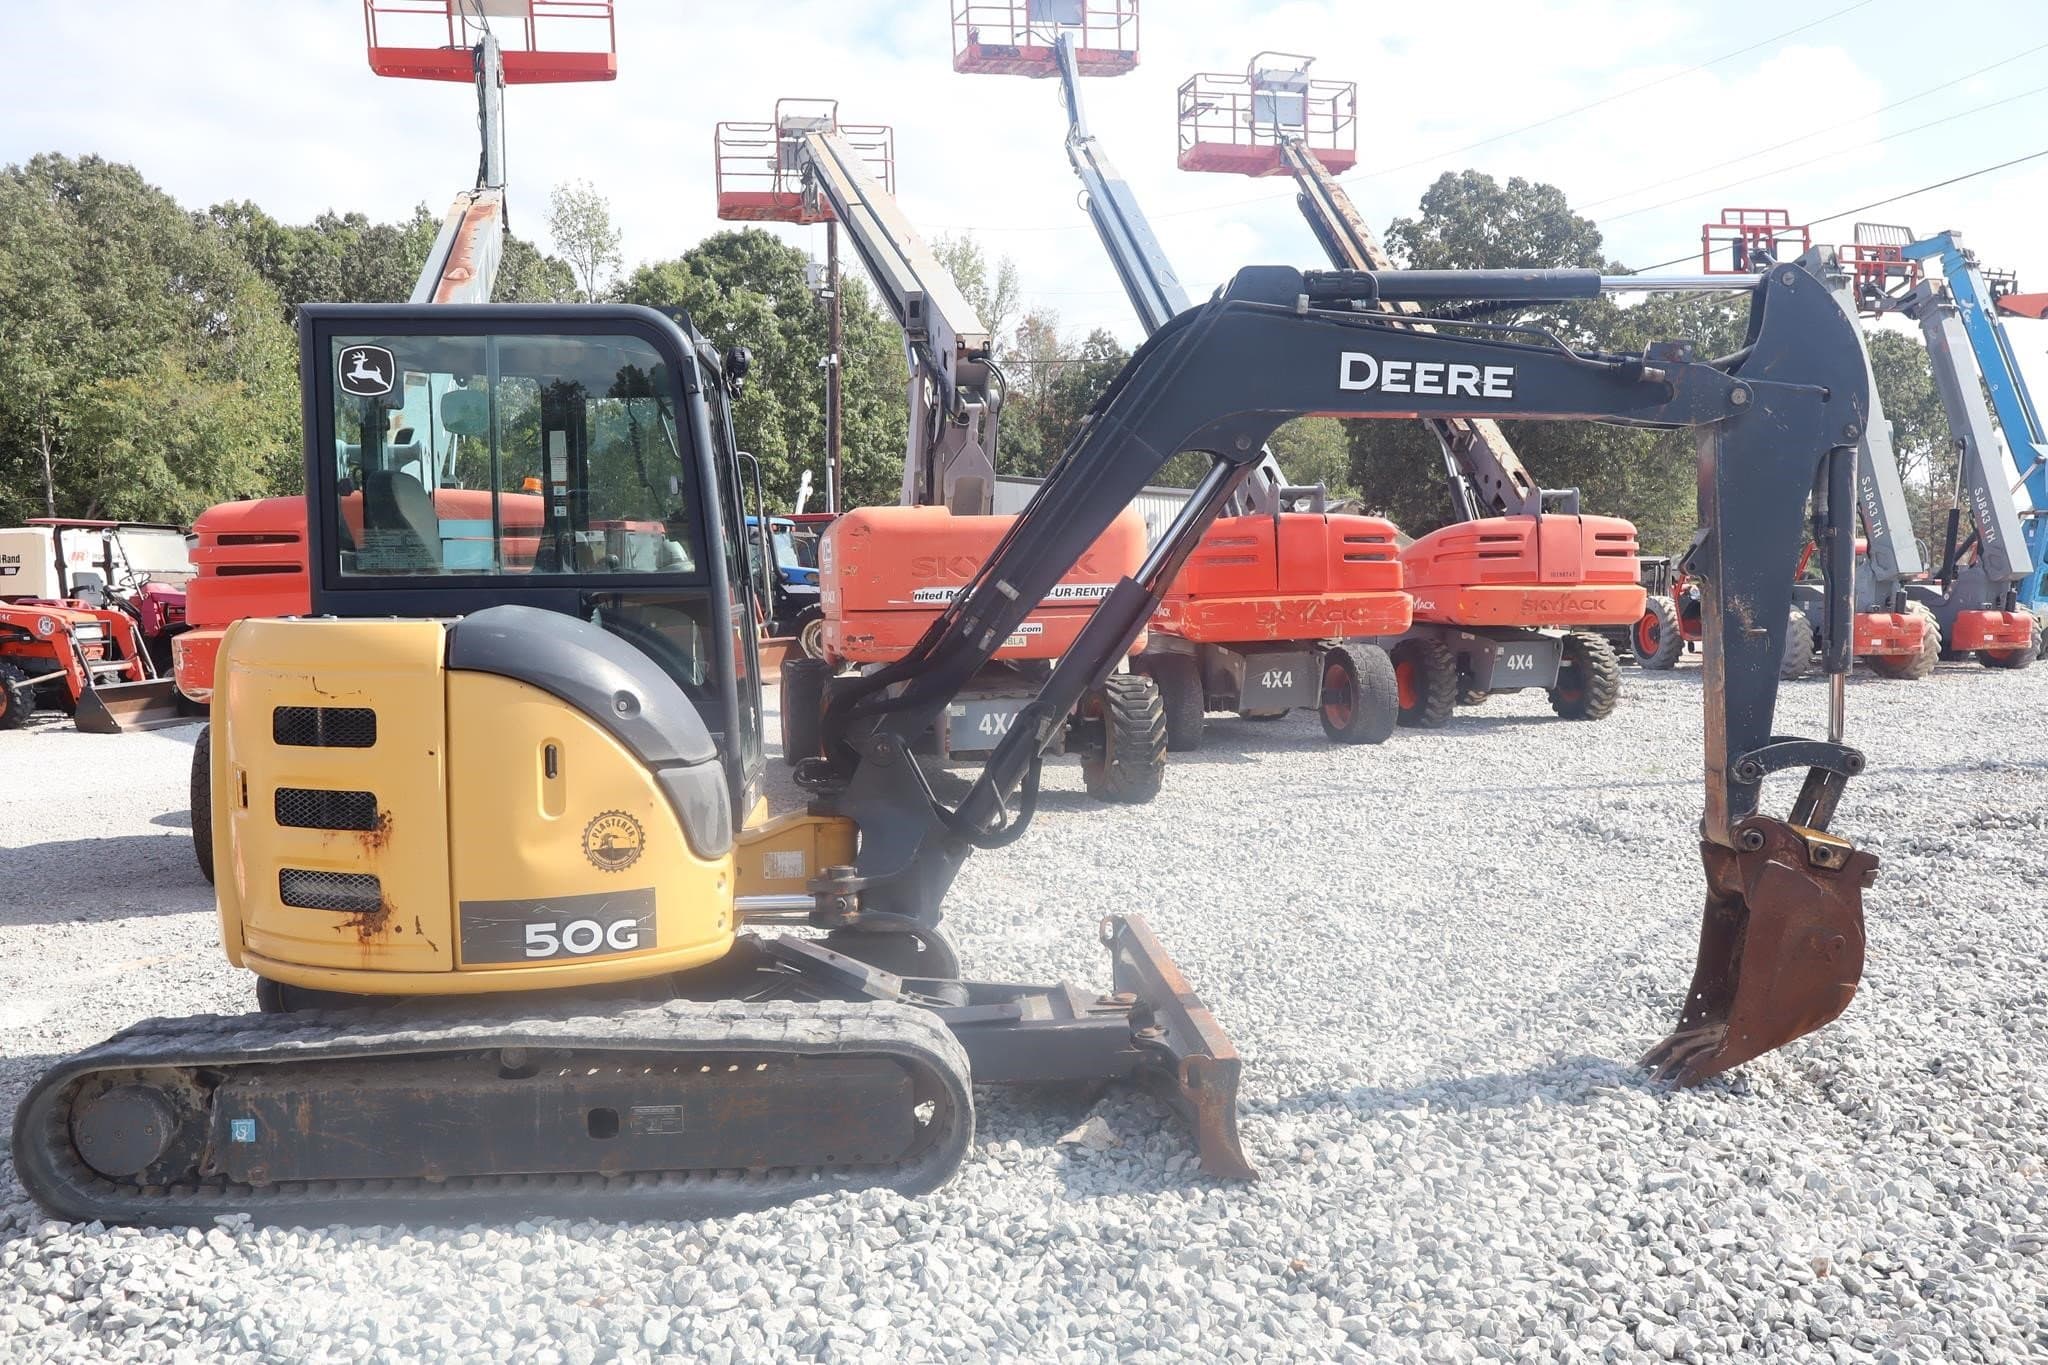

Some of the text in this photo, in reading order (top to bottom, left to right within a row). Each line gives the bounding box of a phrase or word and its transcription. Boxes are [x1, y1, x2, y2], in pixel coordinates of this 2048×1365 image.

[1339, 351, 1515, 399] DEERE
[1861, 476, 1884, 538] SJ843 TH
[1974, 487, 1996, 543] SJ843 TH
[1261, 670, 1293, 688] 4X4
[1506, 654, 1534, 670] 4X4
[591, 817, 637, 839] PLASTERER
[525, 919, 638, 957] 50G
